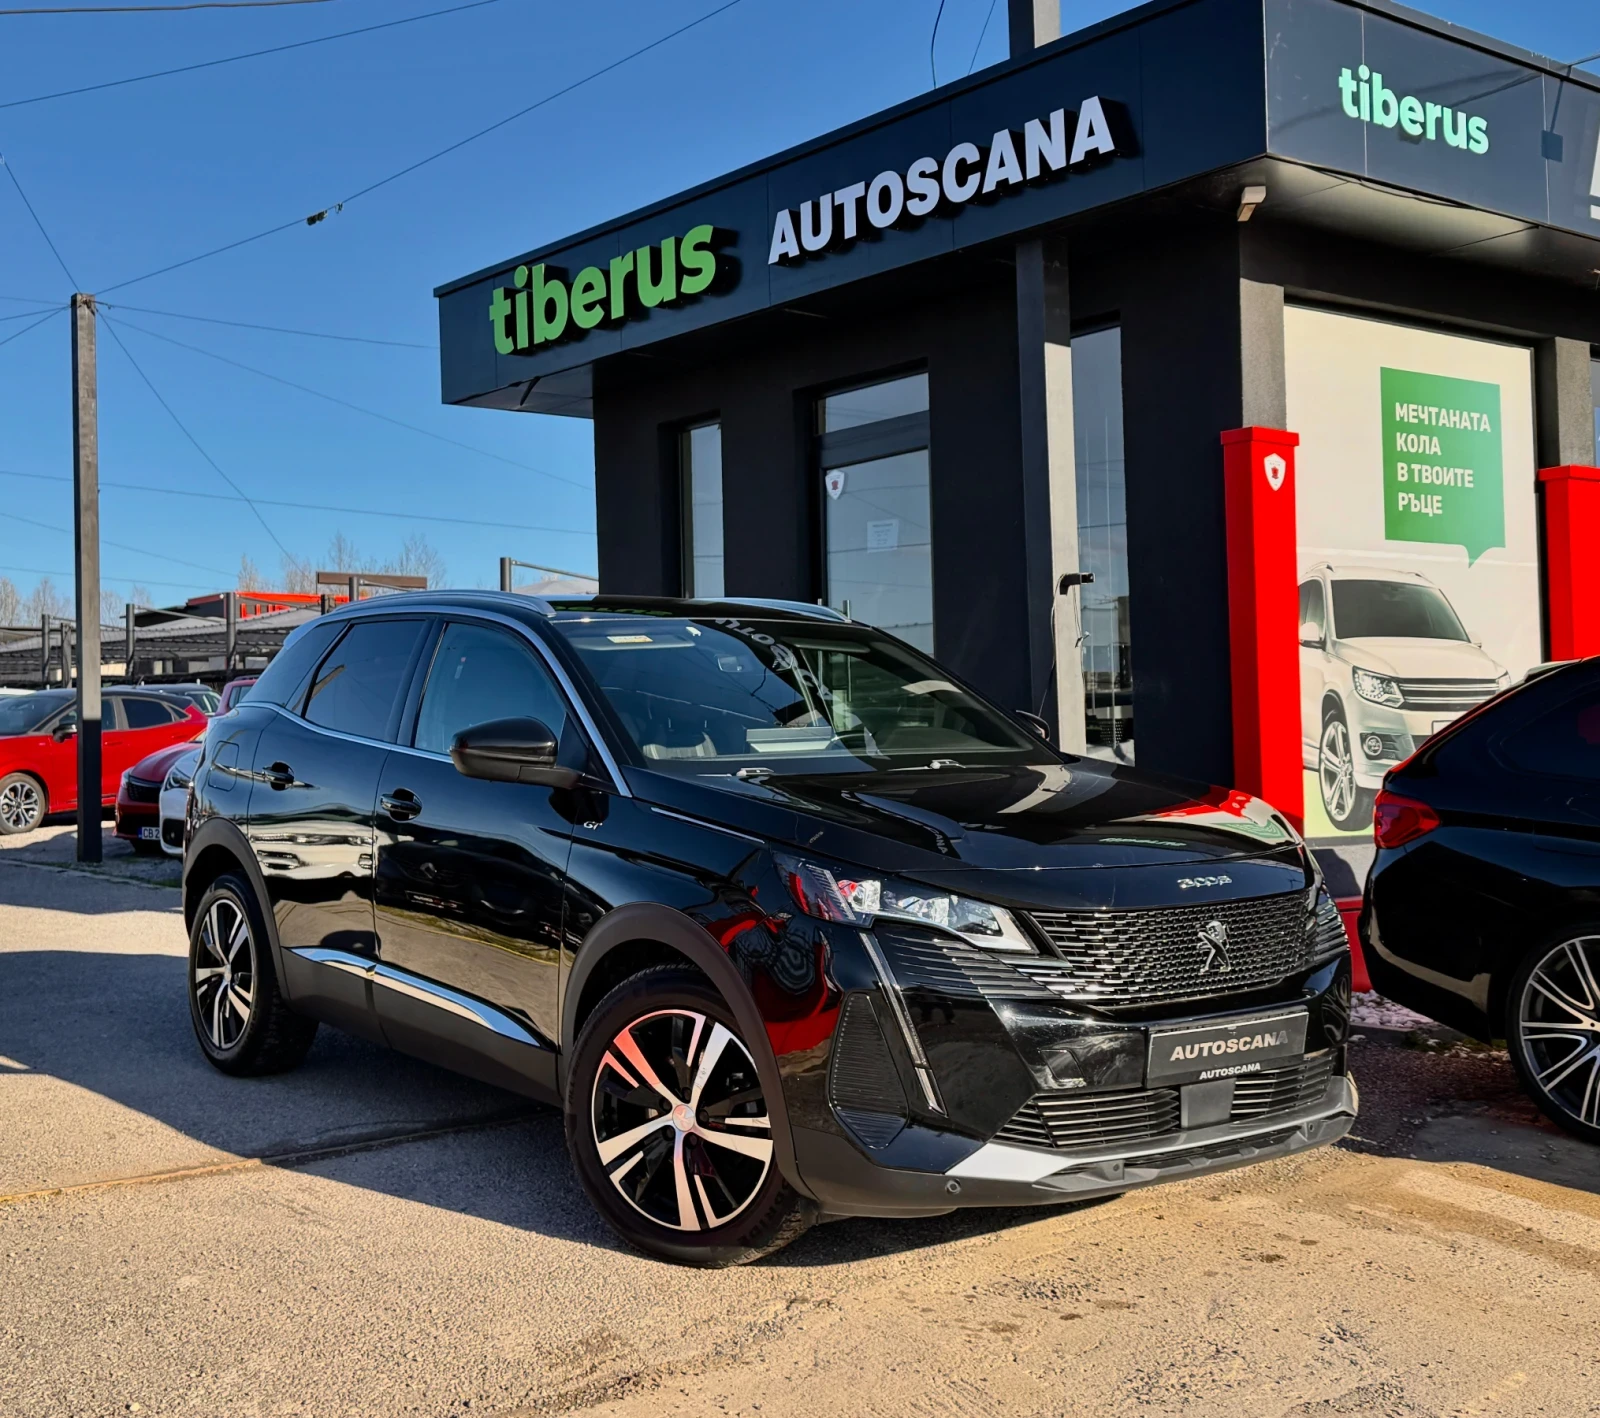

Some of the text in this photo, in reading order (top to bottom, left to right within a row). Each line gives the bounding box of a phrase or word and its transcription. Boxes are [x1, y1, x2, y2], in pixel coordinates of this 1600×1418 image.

[1338, 64, 1489, 155] tiberus
[489, 95, 1115, 355] tiberus AUTOSCANA
[1395, 402, 1491, 432] МЕЧТАНАТА
[1396, 432, 1442, 455] КОЛА
[1397, 462, 1474, 488] В ТВОИТЕ
[1398, 492, 1443, 517] РЪЦЕ
[583, 821, 603, 830] GT
[1170, 1030, 1288, 1061] AUTOSCANA
[1199, 1062, 1261, 1080] AUTOSCANA
